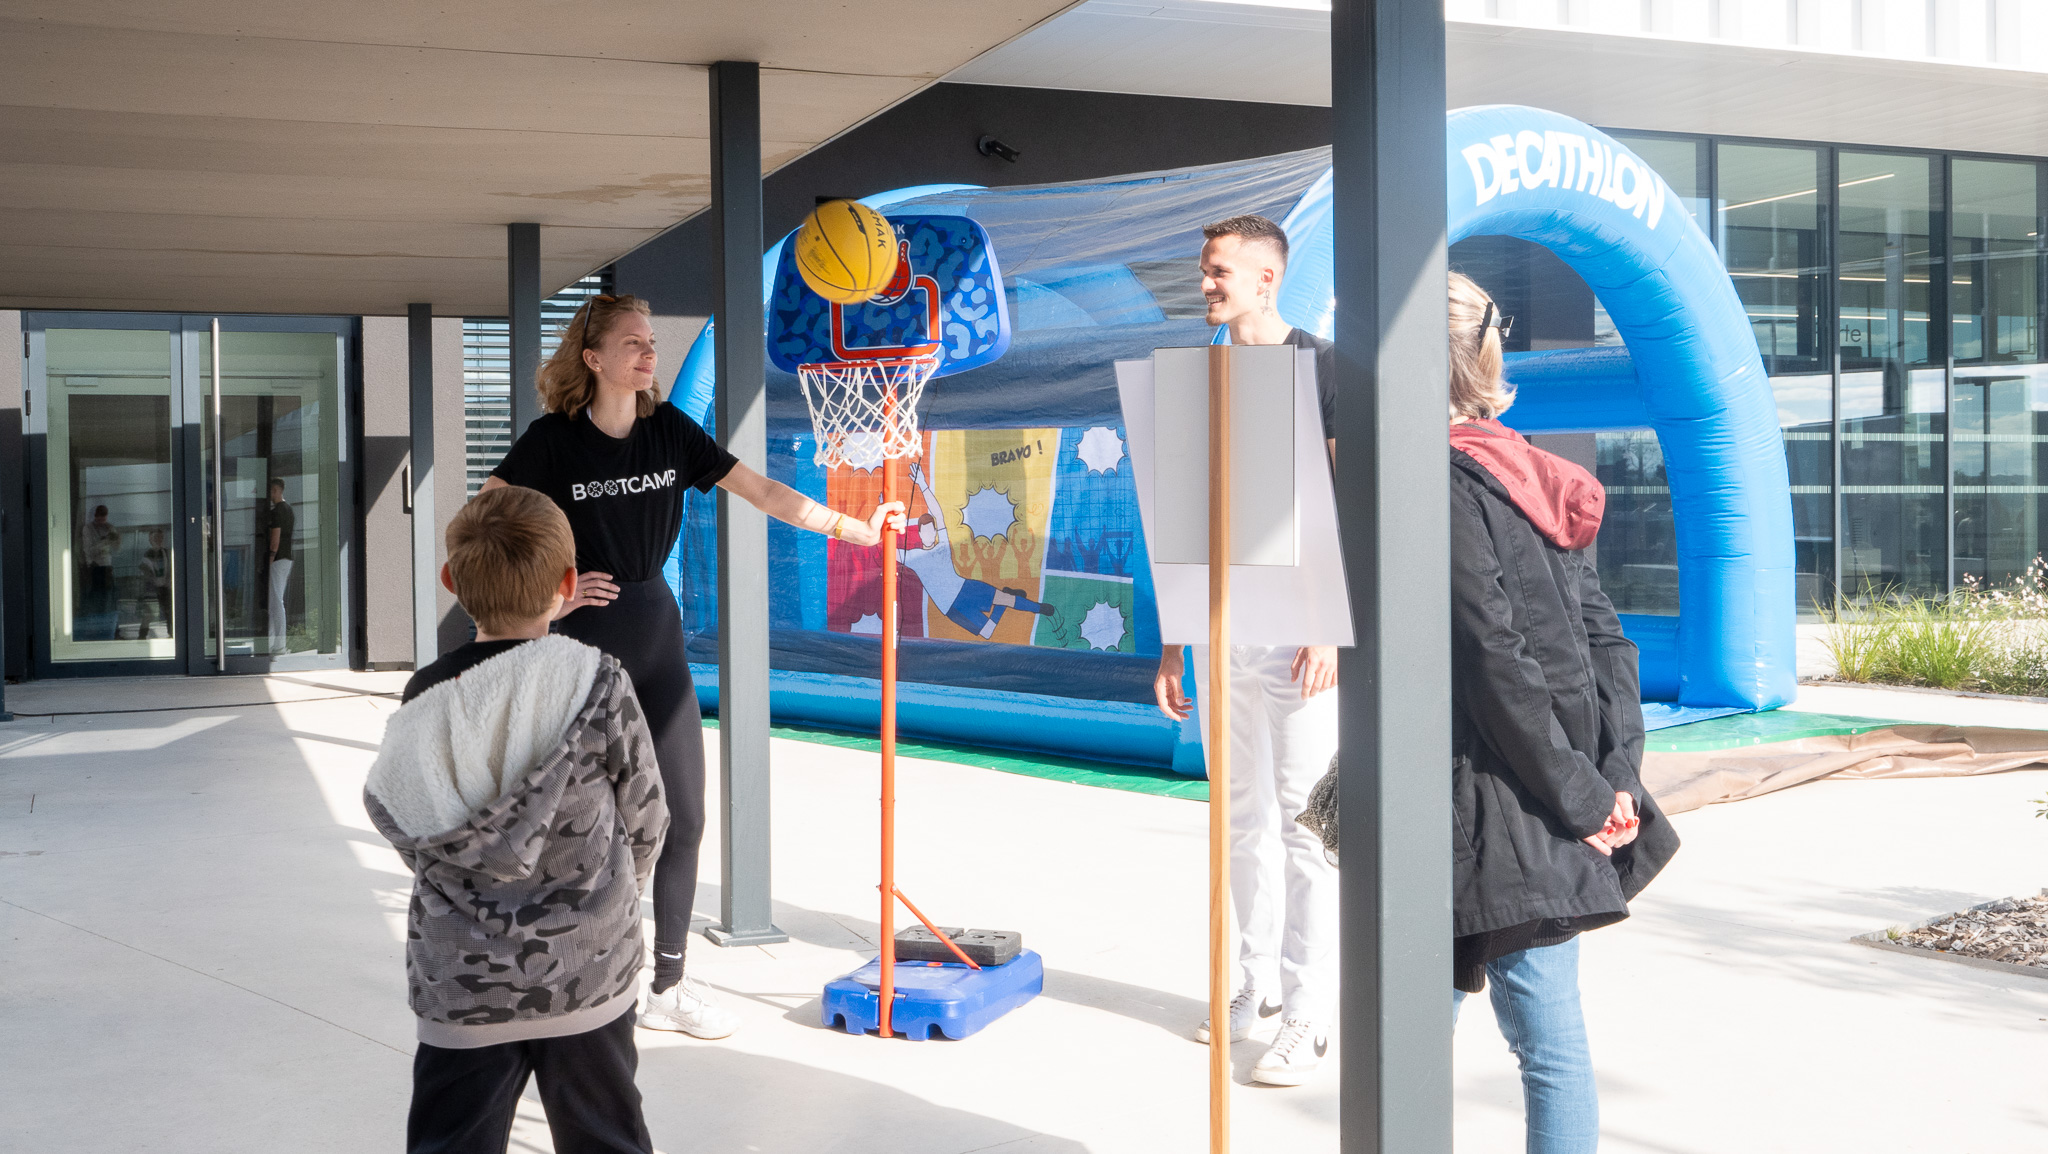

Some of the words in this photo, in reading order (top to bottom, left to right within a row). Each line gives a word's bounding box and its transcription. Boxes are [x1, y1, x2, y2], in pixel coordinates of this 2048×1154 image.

[1461, 130, 1665, 230] DECATHLON
[868, 209, 886, 248] RMAK
[991, 445, 1031, 467] BRAVO
[572, 469, 676, 501] BOOTCAMP
